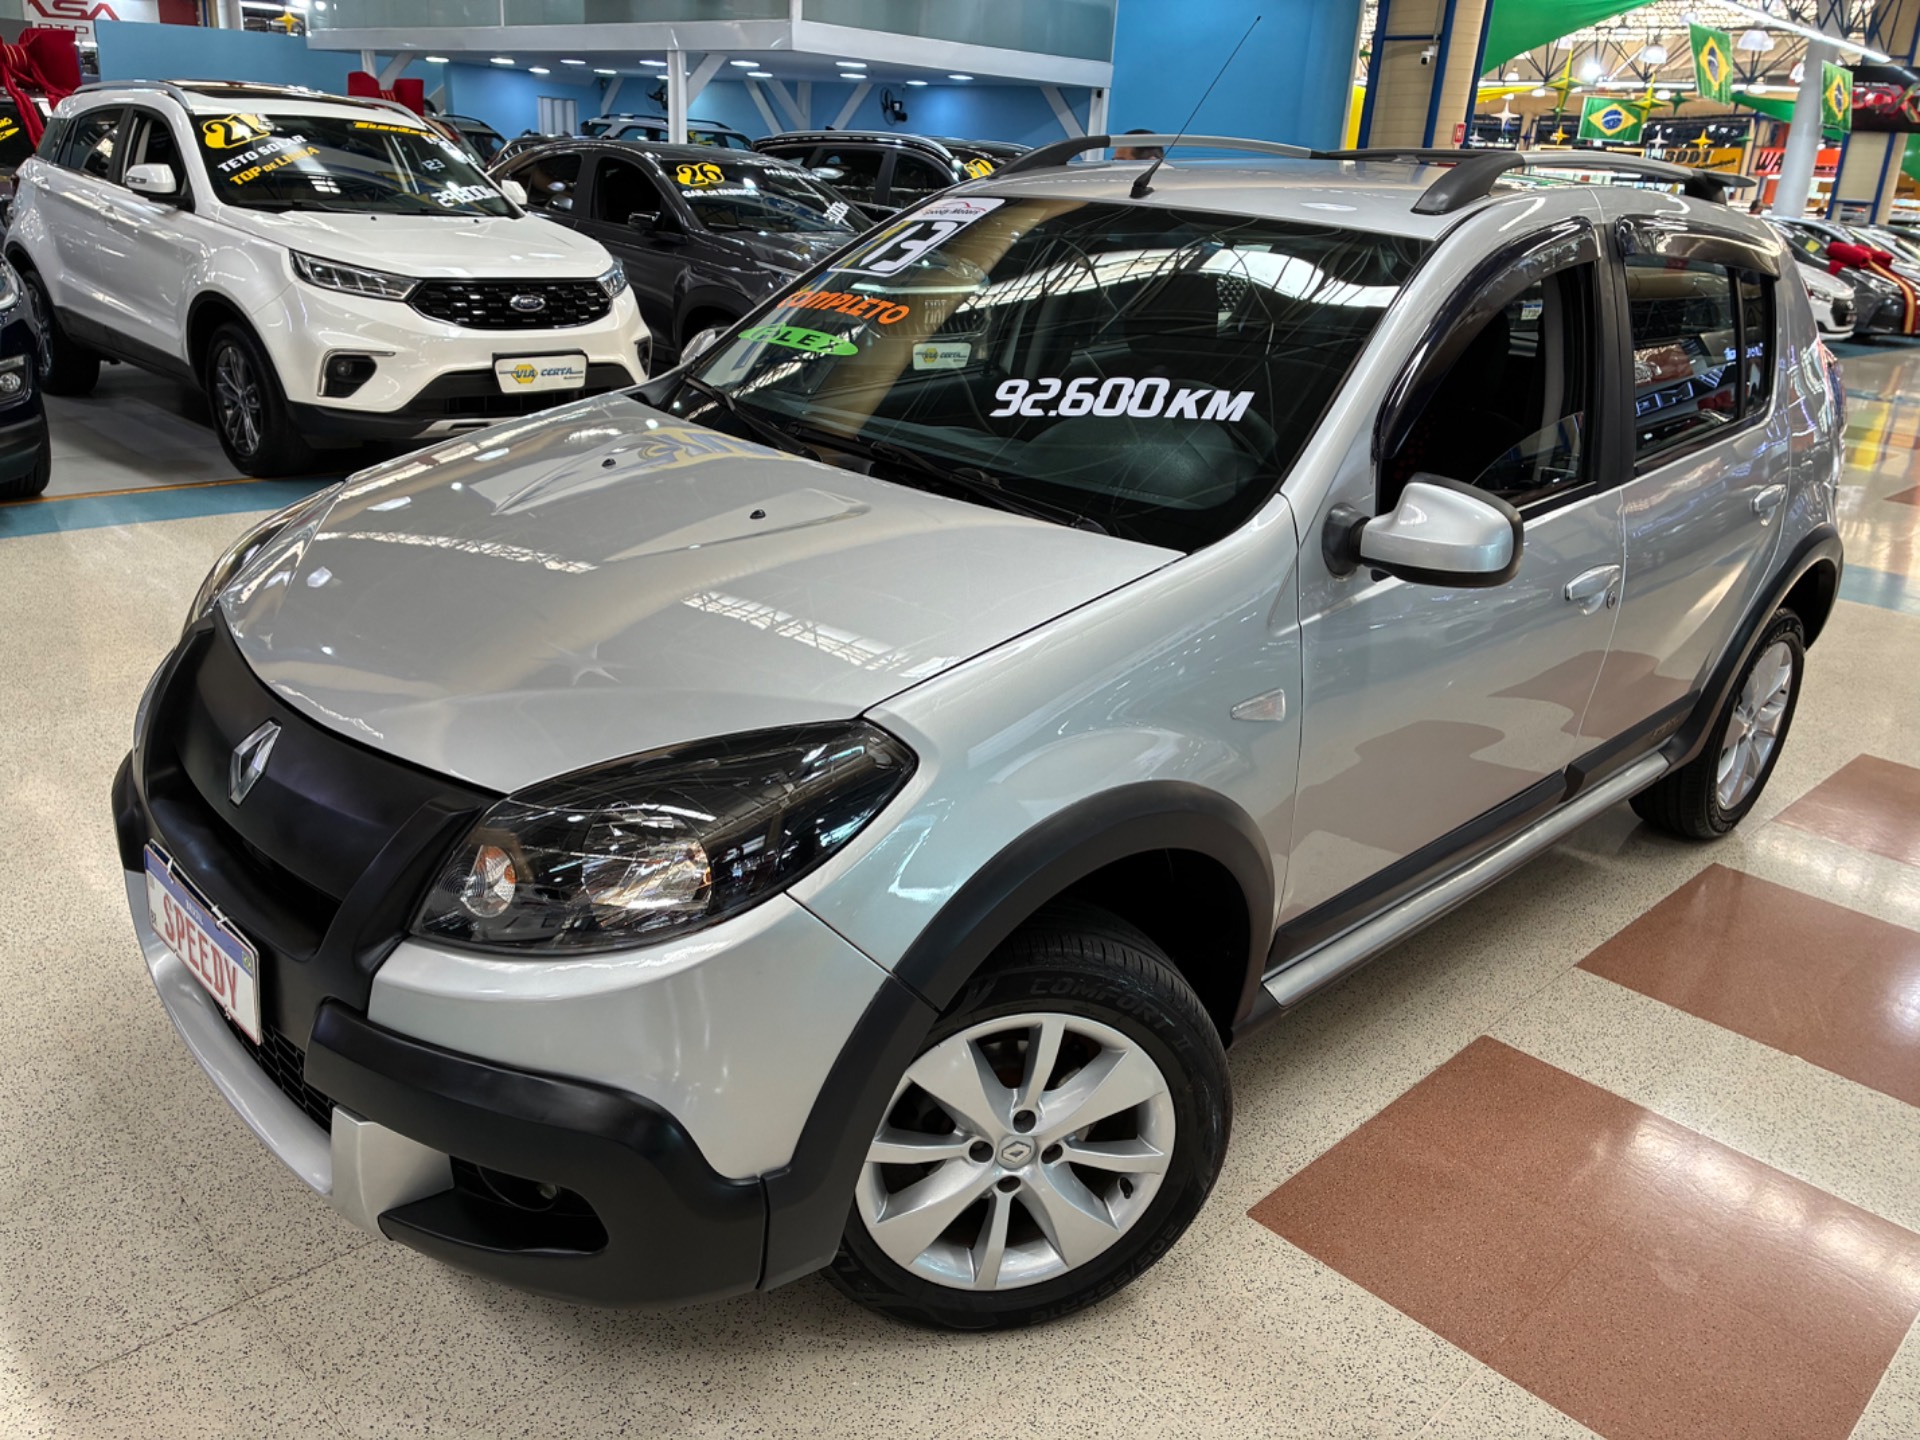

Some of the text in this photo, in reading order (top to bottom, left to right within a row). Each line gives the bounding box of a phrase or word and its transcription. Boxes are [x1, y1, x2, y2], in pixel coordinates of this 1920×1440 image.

[203, 113, 270, 149] 21
[217, 134, 308, 172] TETO SOLAR
[229, 166, 262, 185] TOP
[678, 164, 724, 185] 26
[858, 221, 958, 272] 13
[777, 291, 911, 326] COMPLETO
[515, 366, 574, 379] VIA CERTA
[162, 893, 239, 1011] SPEEDY
[1029, 976, 1176, 1033] COMFORT
